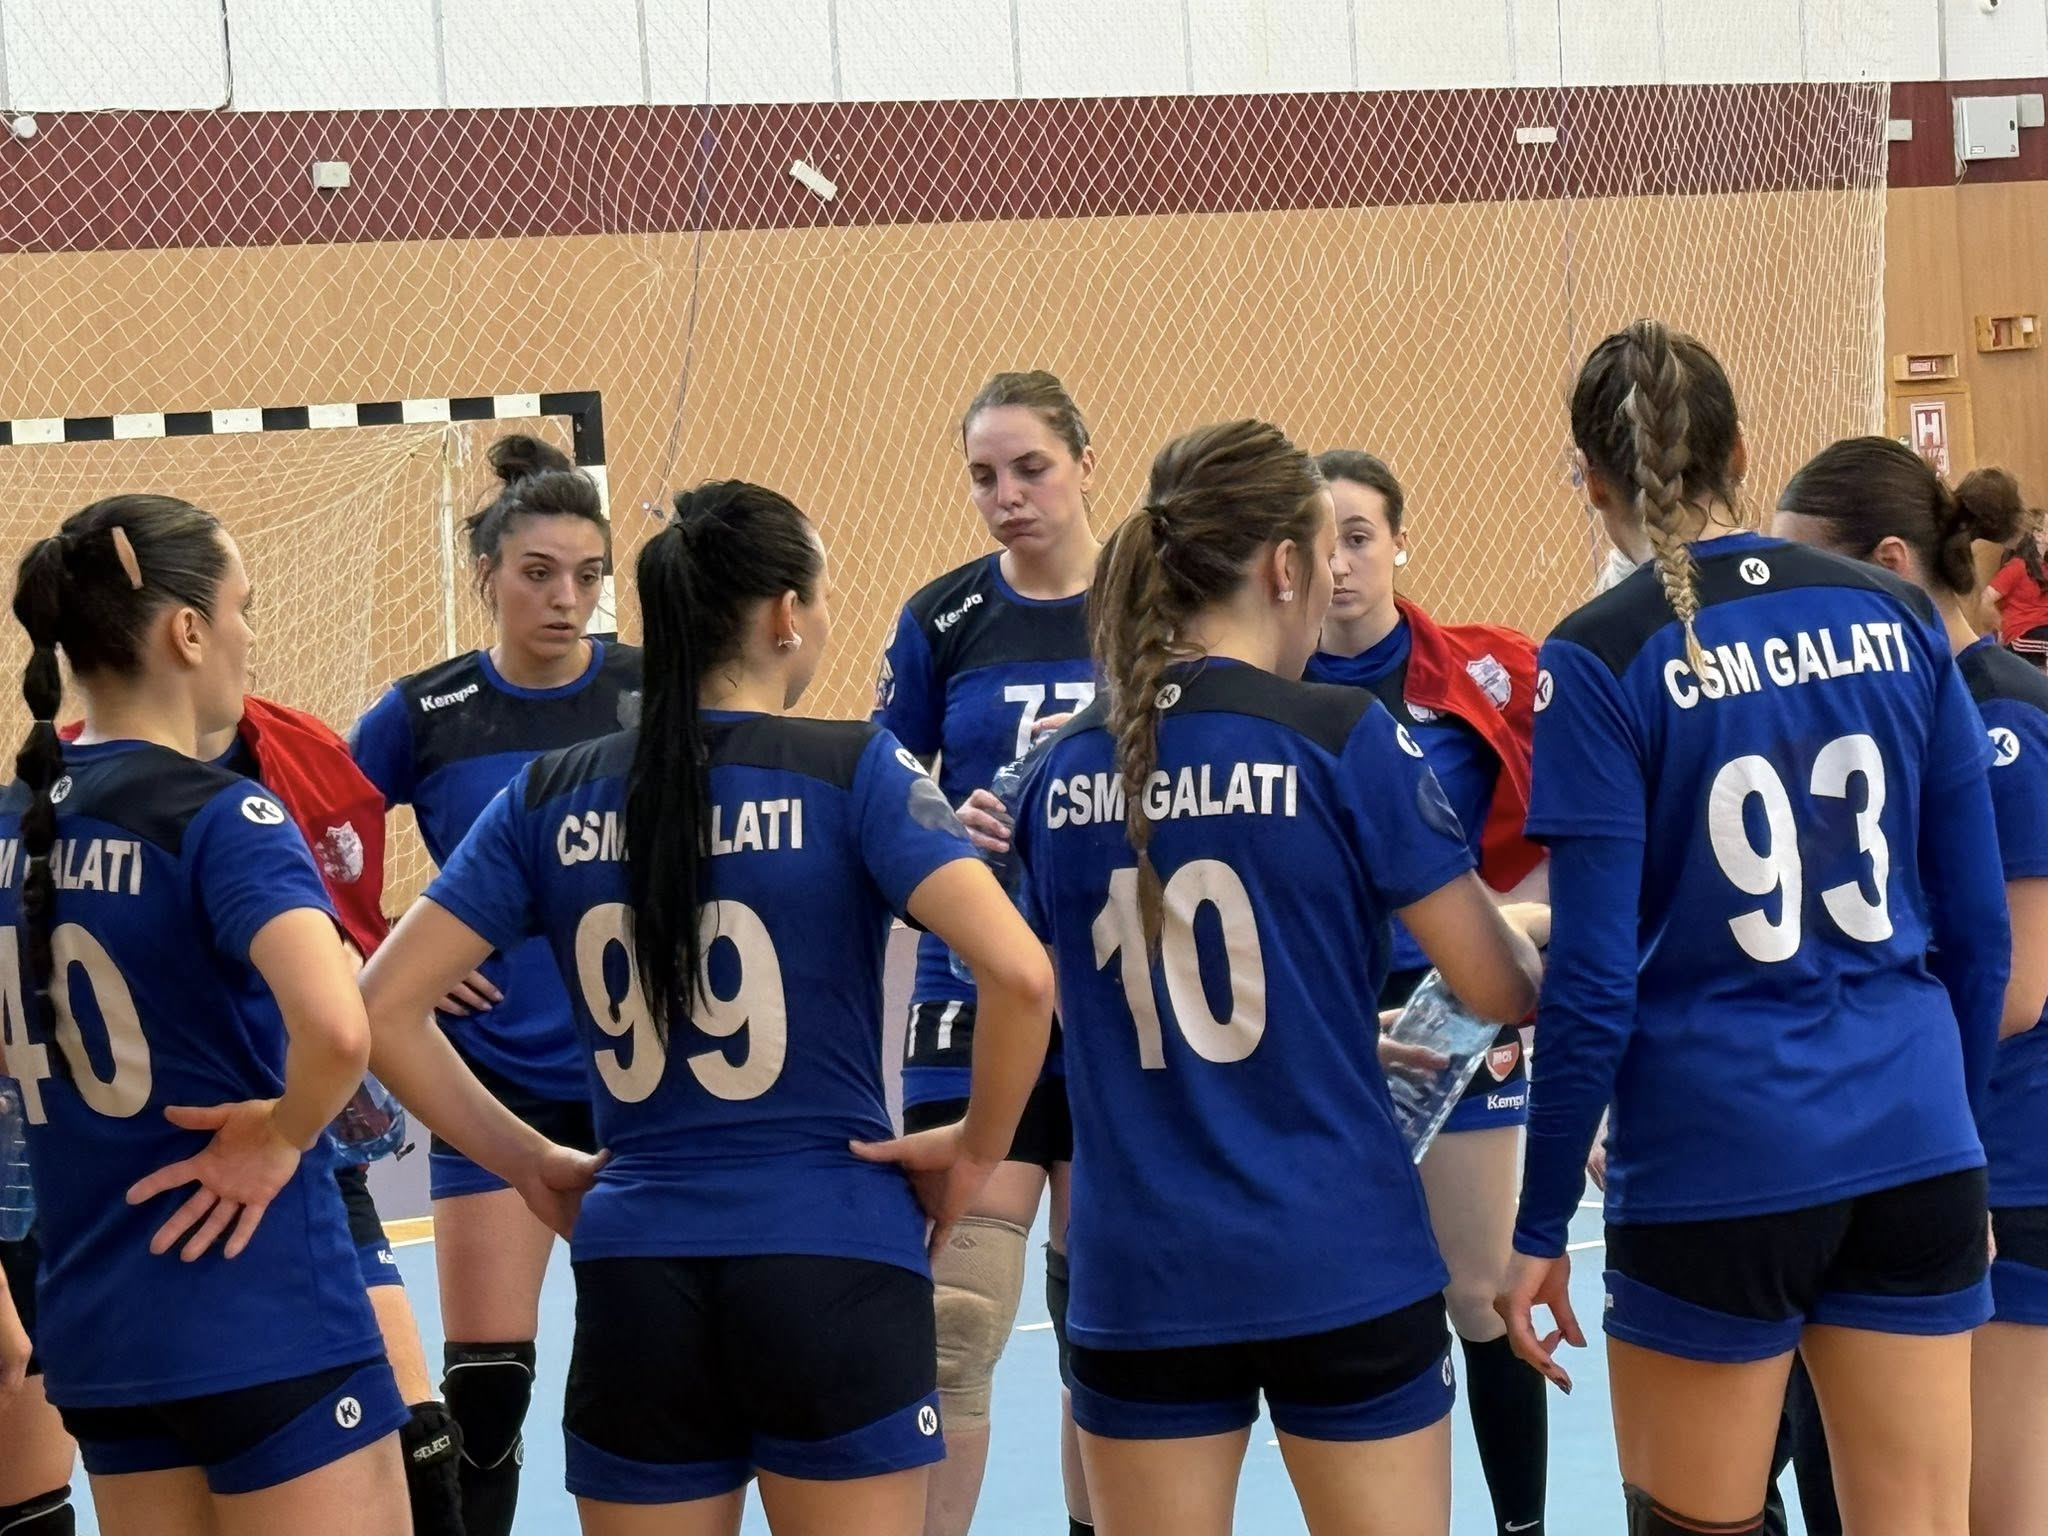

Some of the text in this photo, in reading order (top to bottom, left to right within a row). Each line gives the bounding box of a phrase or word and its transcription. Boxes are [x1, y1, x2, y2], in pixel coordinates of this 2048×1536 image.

[420, 683, 479, 712] Kempa
[1664, 623, 1910, 709] CSM GALATI
[1047, 762, 1298, 830] CSM GALATI
[1708, 734, 1894, 963] 93
[0, 922, 153, 1125] 40
[575, 899, 788, 1104] 99
[1091, 858, 1267, 1070] 10
[1487, 1094, 1526, 1110] Kemp
